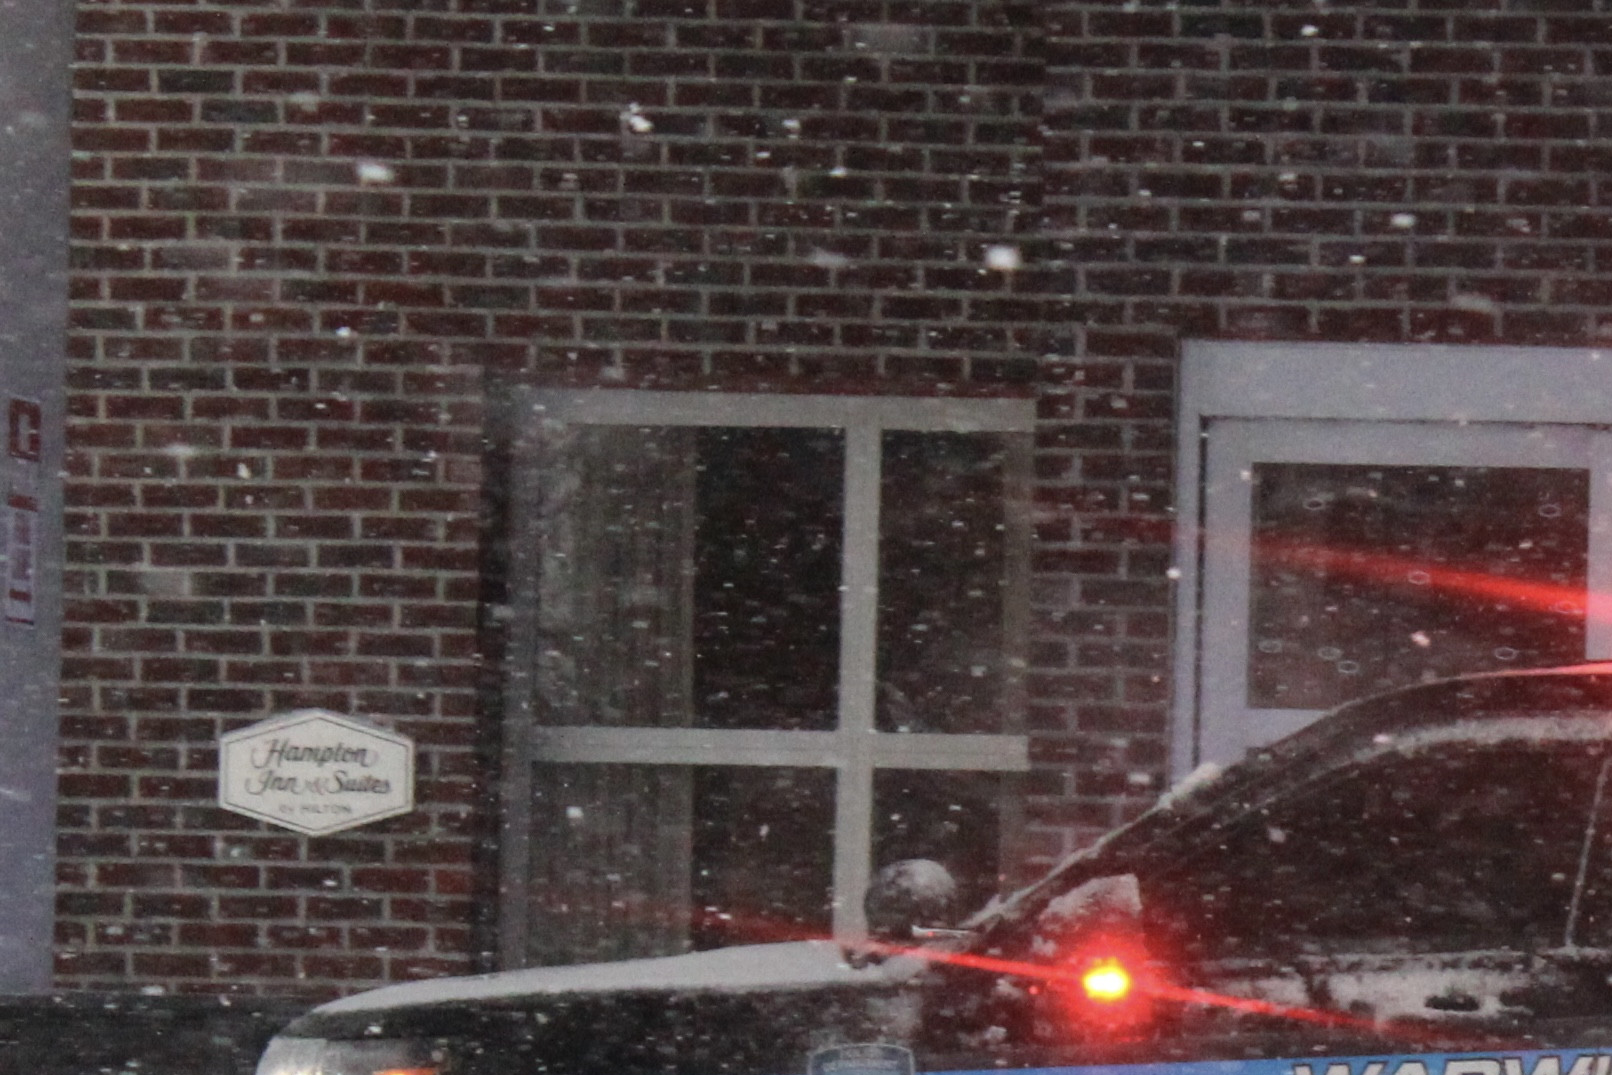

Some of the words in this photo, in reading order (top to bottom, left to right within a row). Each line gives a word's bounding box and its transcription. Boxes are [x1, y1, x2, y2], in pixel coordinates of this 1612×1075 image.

[252, 738, 379, 768] Hampton
[245, 769, 301, 795] Inn
[327, 769, 391, 794] Suites
